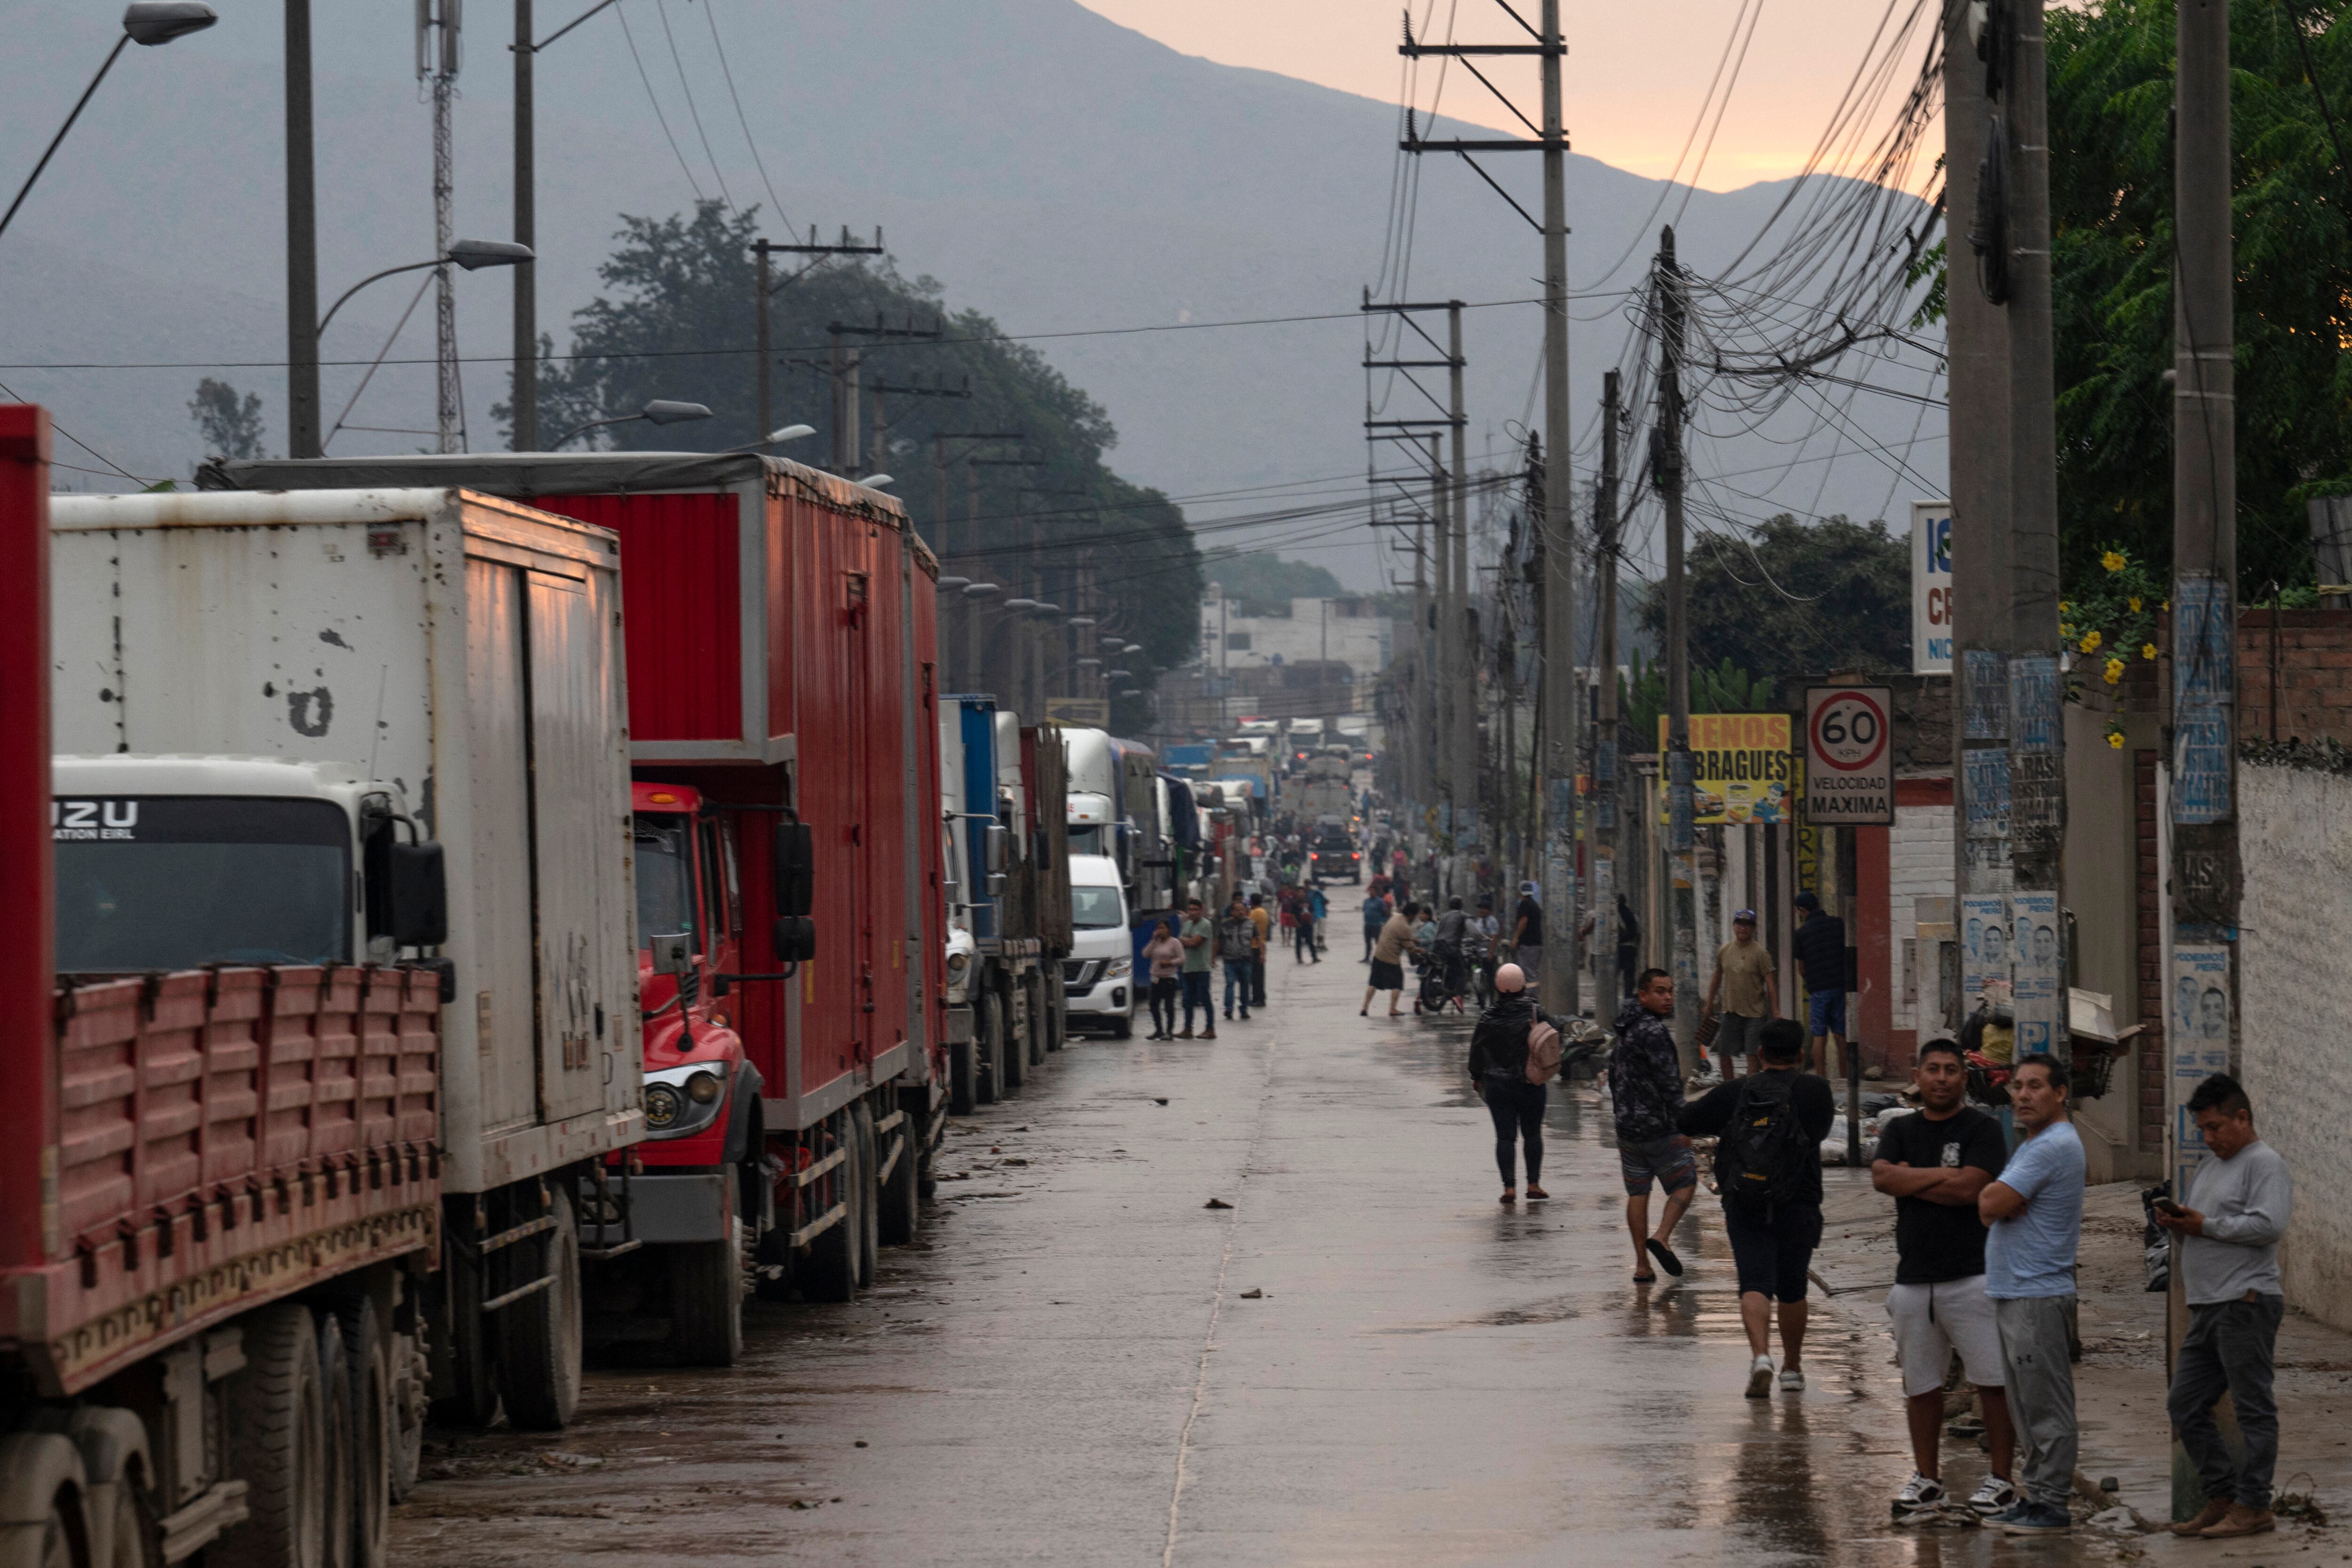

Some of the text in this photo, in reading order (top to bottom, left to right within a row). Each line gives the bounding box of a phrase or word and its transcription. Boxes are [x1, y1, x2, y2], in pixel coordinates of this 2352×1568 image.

[1822, 711, 1876, 744] 60
[1663, 750, 1788, 780] EBRAGUES
[1813, 777, 1886, 790] VELOCIDAD
[1812, 797, 1888, 813] MAXIMA
